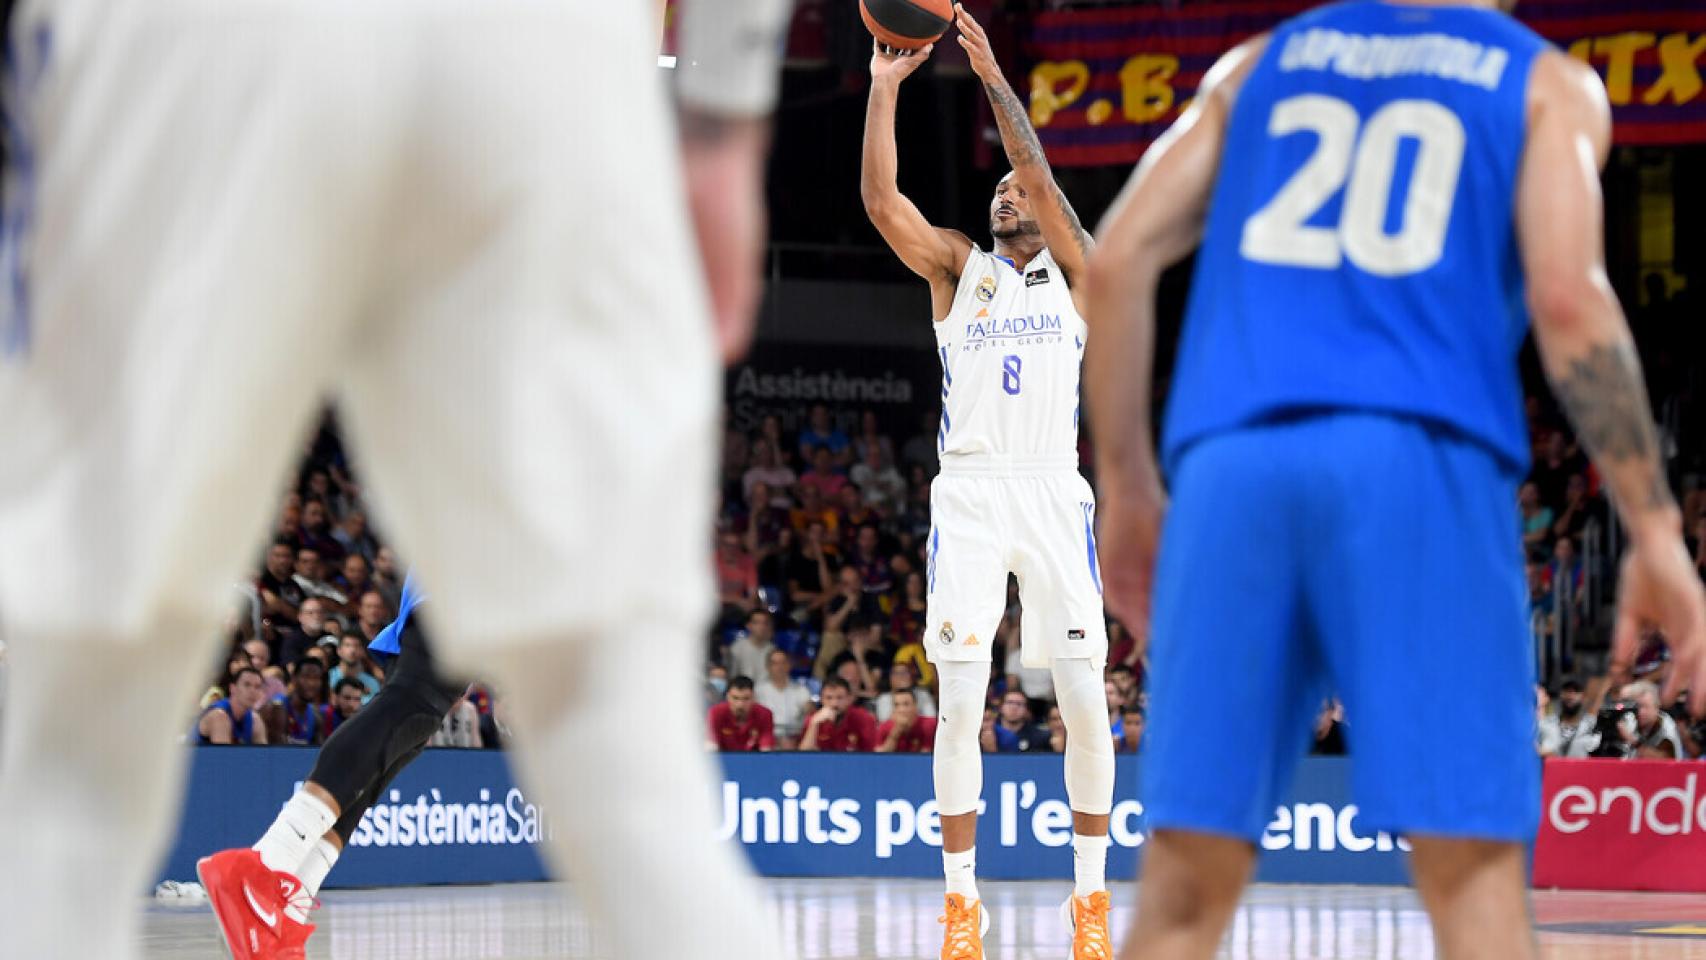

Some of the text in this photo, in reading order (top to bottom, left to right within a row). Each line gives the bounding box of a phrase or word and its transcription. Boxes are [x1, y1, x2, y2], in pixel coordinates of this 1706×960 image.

[1240, 93, 1466, 277] 20
[1002, 355, 1023, 396] 8
[875, 798, 986, 858] pe
[1550, 773, 1706, 836] end
